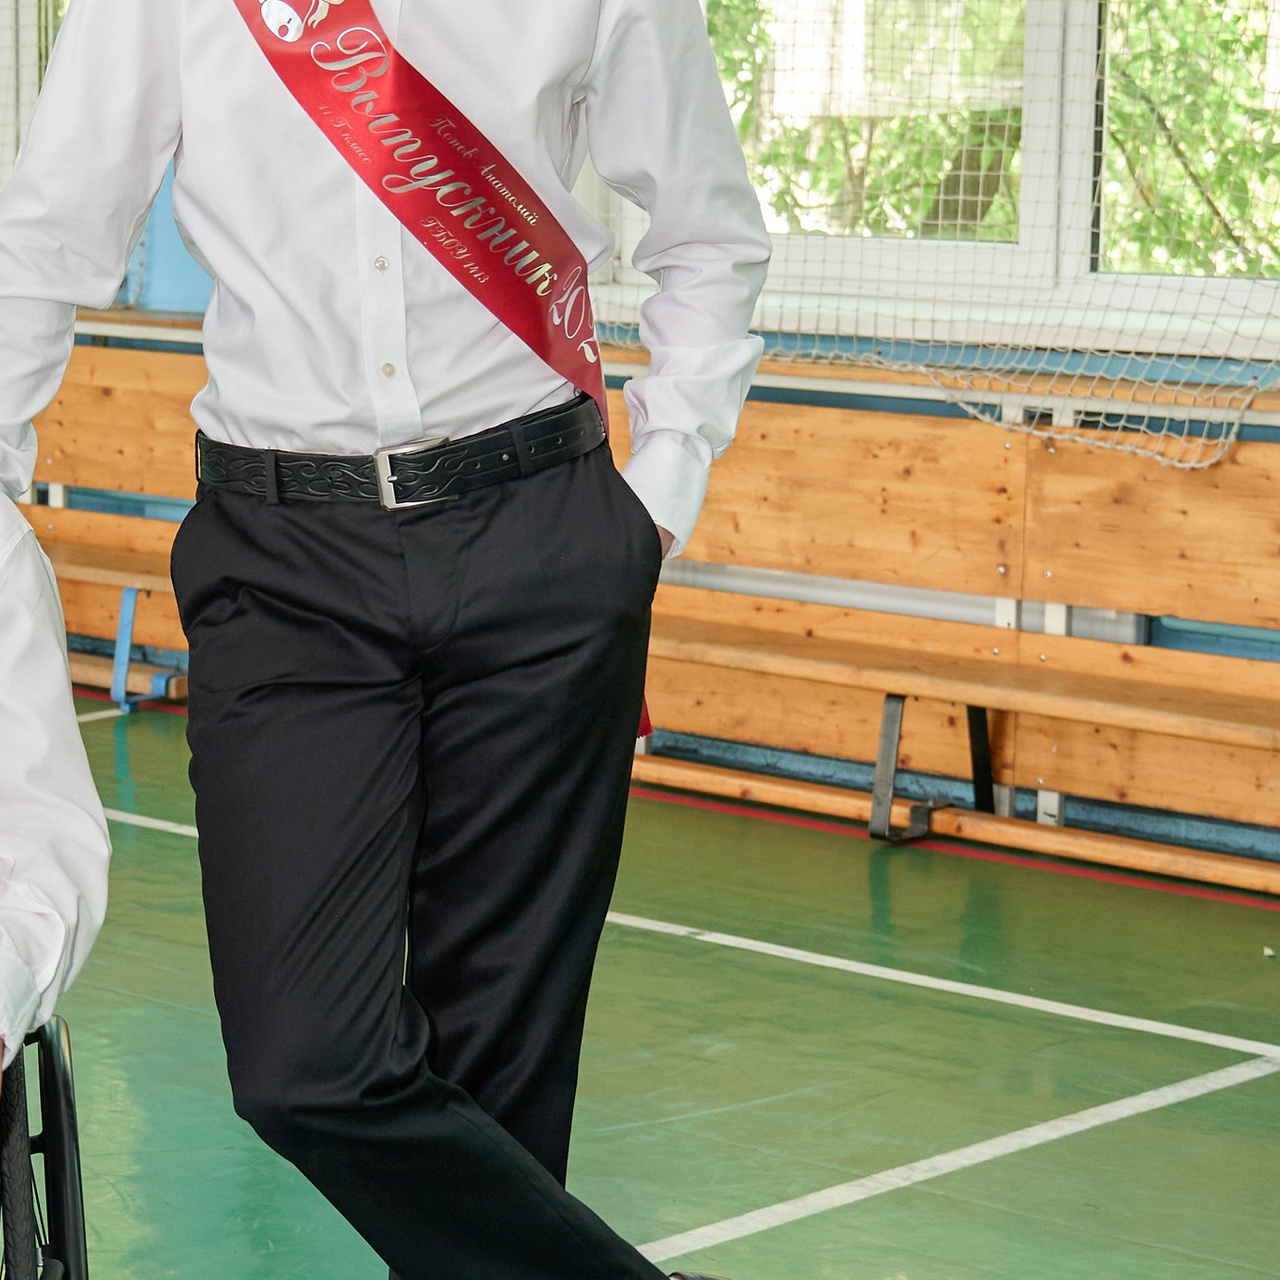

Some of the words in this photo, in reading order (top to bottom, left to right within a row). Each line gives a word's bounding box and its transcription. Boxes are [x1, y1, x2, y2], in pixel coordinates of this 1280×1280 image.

[310, 26, 558, 297] Выпускник
[341, 132, 372, 164] класс
[429, 115, 479, 160] Попов
[478, 163, 540, 227] Анатолий
[421, 216, 472, 260] ГБОУ
[463, 259, 489, 285] 1413
